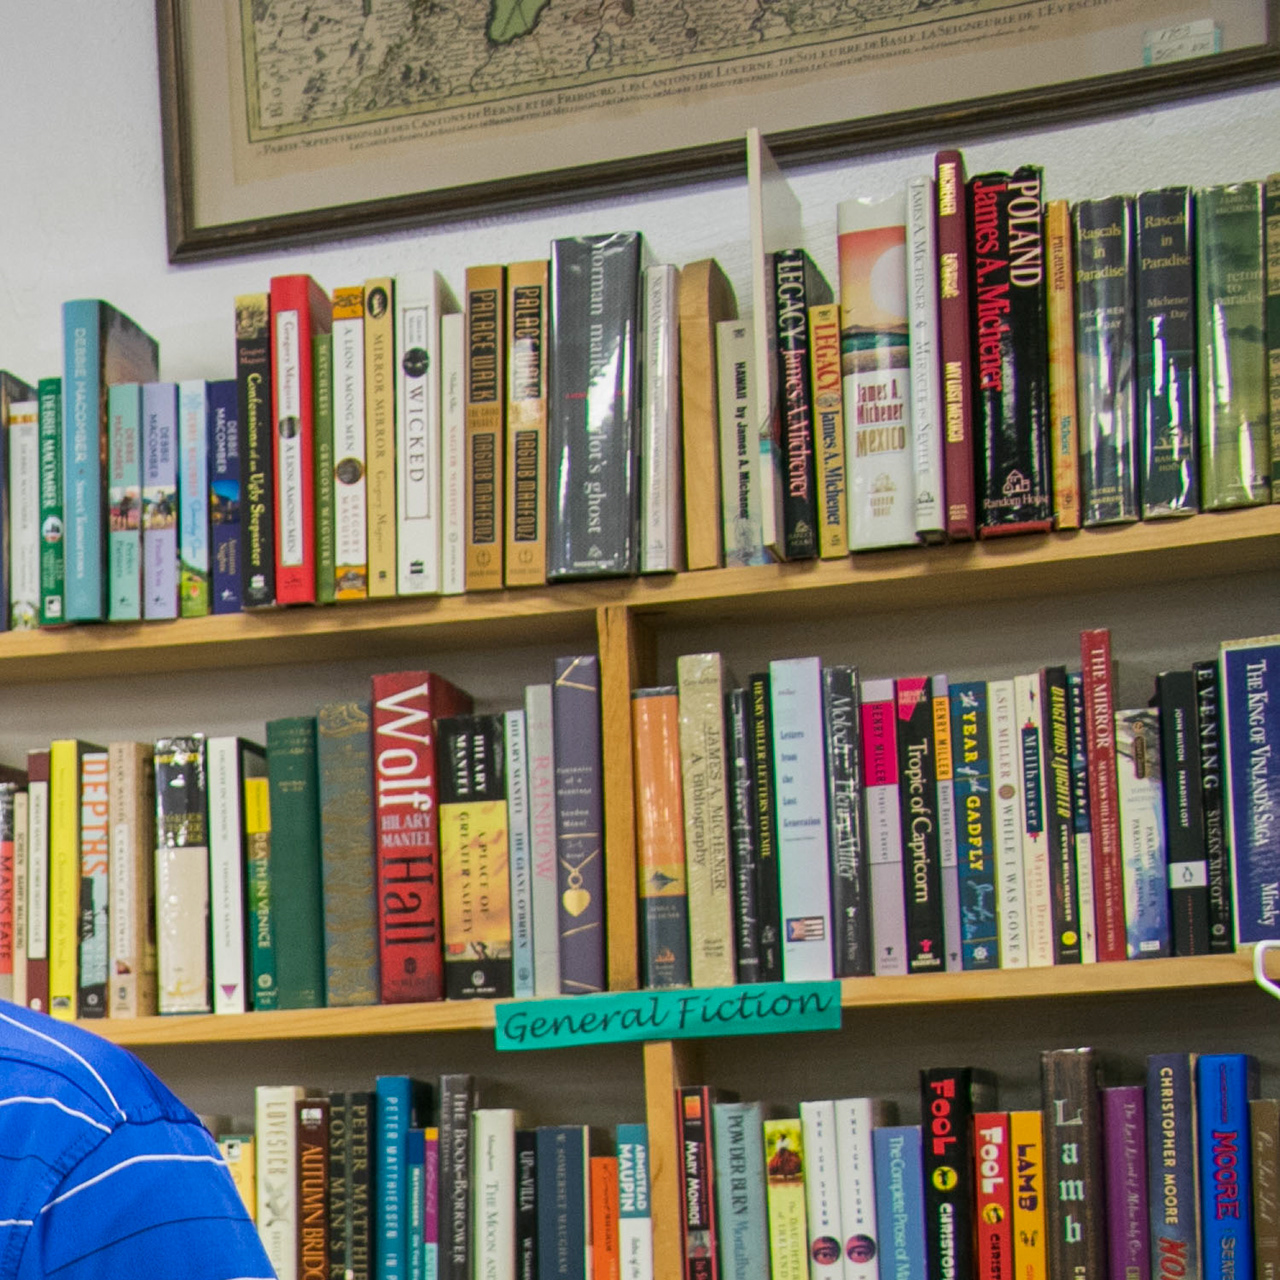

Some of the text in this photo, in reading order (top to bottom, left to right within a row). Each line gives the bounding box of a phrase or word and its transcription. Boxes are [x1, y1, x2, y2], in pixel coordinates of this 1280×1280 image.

[940, 163, 955, 215] MICHENER
[1009, 179, 1042, 288] POLAND
[1078, 223, 1122, 239] Rascals
[1093, 245, 1106, 259] in
[777, 257, 807, 348] LEGACY
[974, 180, 1011, 392] James A. Michener
[1076, 263, 1124, 283] Paradise
[470, 291, 497, 403] PALACE WALK
[784, 350, 804, 403] James
[815, 323, 840, 395] LEGACY
[74, 327, 88, 463] DEBBIE MACOMBER
[247, 372, 260, 447] Confessions
[373, 333, 385, 460] MIRROR MIRROR
[857, 382, 891, 403] James
[857, 402, 904, 425] Michener
[947, 377, 962, 402] LOST
[947, 402, 964, 442] MEXICO
[407, 385, 424, 484] WICKED
[788, 421, 811, 500] Michener
[249, 472, 266, 499] Ugly
[473, 435, 495, 543] NAGUIB MAHFOUZ
[251, 502, 266, 567] Stepsister
[1091, 647, 1108, 750] THE MIRROR
[1199, 669, 1217, 789] EVENING
[376, 682, 432, 812] Wolf
[456, 734, 468, 794] MANTEL
[474, 734, 486, 792] HILARY
[872, 705, 885, 784] HENRY MILLER
[962, 710, 977, 764] YEAR
[1247, 660, 1274, 846] THE KING OF VINLAND'S SAGA
[82, 758, 108, 877] DEPTHS
[1025, 733, 1037, 827] Millhauser
[381, 813, 430, 830] HILARY
[381, 831, 431, 847] MANTEL
[909, 739, 931, 903] Tropic of Capricorn
[966, 795, 982, 872] GADFLY
[256, 833, 270, 948] DEATH IN VENICE
[384, 856, 436, 946] Hall
[460, 812, 471, 934] GREATER SAFETY
[478, 844, 487, 887] PLACE
[0, 855, 11, 960] MAN'S FATE
[479, 895, 489, 917] OF
[1257, 883, 1279, 926] Mirsky
[504, 991, 834, 1042] General Fiction
[332, 1106, 344, 1166] LOST
[353, 1105, 366, 1171] PETER
[930, 1077, 955, 1157] FOOL
[1159, 1067, 1177, 1226] CHRISTOPHER MOORE
[301, 1144, 324, 1224] AUTUMN
[453, 1093, 466, 1264] THE BOOK-BORROWER
[620, 1144, 634, 1212] MAUPIN
[635, 1144, 646, 1210] ARMISTEAD
[684, 1140, 699, 1226] MARY MONROE
[980, 1127, 1003, 1194] FOOL
[1017, 1143, 1037, 1211] LAMB
[1213, 1130, 1239, 1220] MOORE
[332, 1177, 345, 1249] MAN'S
